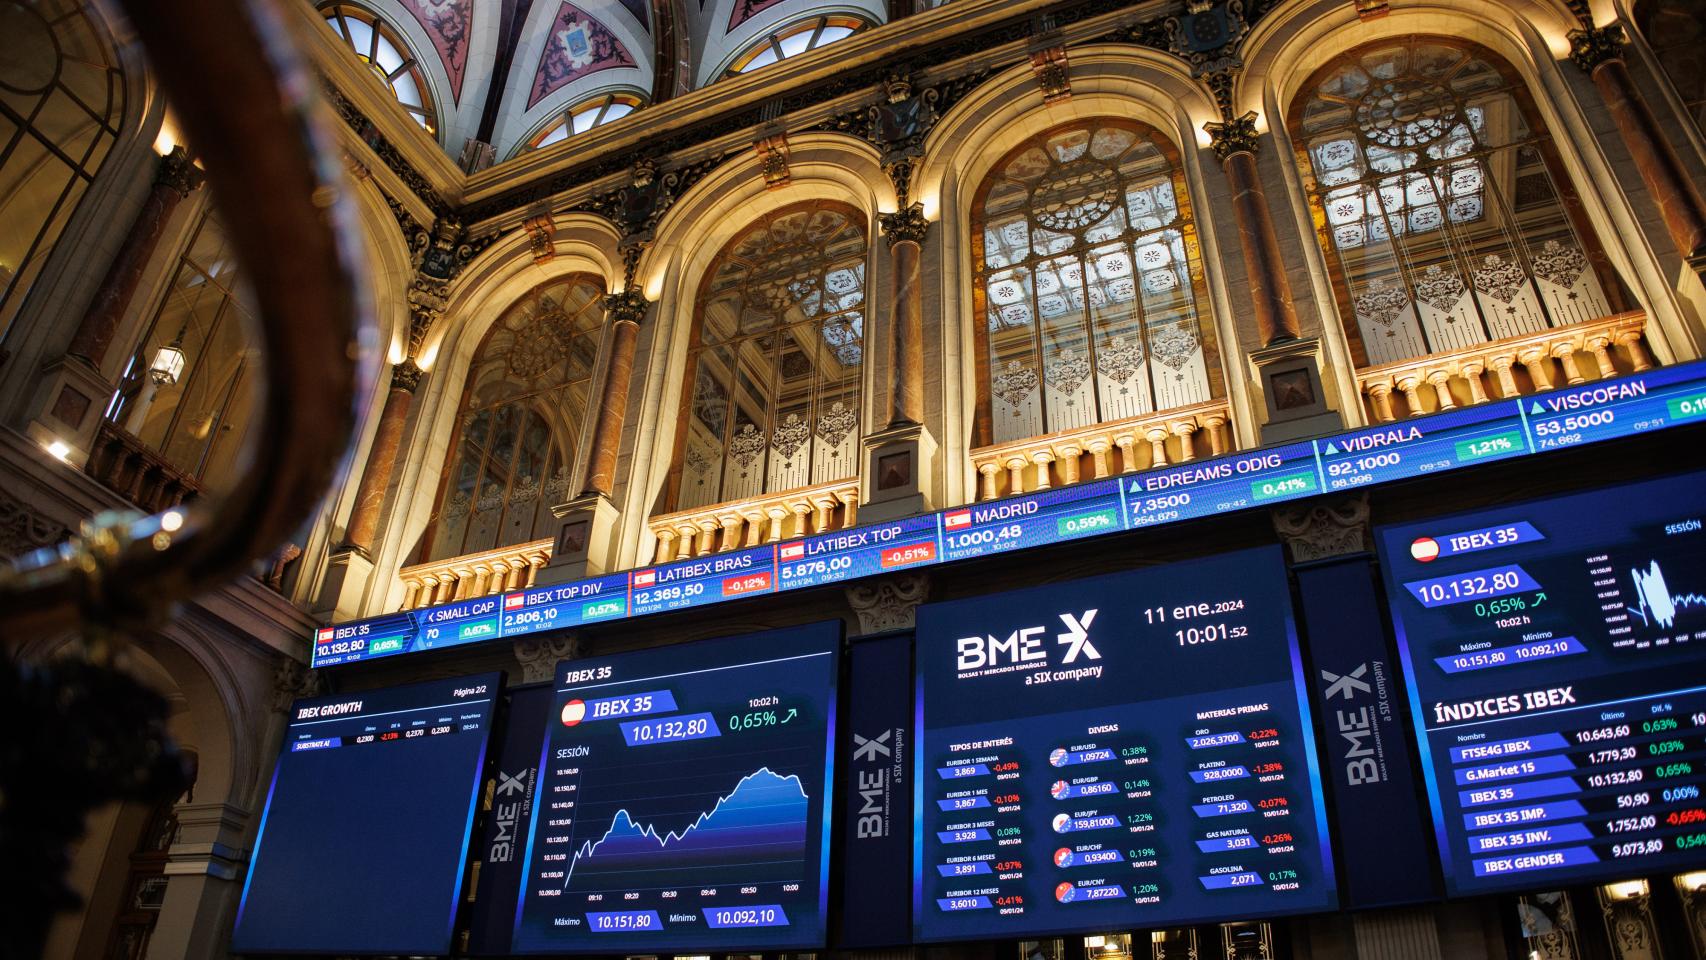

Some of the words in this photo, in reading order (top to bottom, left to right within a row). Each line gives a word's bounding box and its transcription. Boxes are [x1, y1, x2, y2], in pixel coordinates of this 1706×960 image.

[1548, 380, 1646, 412] VISCOFAN
[1536, 411, 1614, 436] 53,5000
[1634, 418, 1664, 430] 09:51
[1342, 427, 1423, 452] VIDRALA
[1468, 438, 1511, 455] 1,21%
[1328, 452, 1400, 476] 92,1000
[1146, 464, 1232, 491] EDREAMS
[1236, 454, 1282, 474] ODIG
[1262, 478, 1306, 494] 0,41%
[1130, 494, 1190, 514] 7,3500
[975, 501, 1038, 524] MADRID
[1066, 515, 1109, 530] 0,59%
[1665, 520, 1702, 534] SESIÓN
[808, 533, 868, 555] LATIBEX
[871, 526, 902, 542] TOP
[947, 525, 1022, 549] 1.000,48
[1450, 532, 1494, 552] IBEX
[1496, 528, 1518, 544] 35
[887, 547, 928, 562] -0,51%
[658, 562, 712, 582] LATIBEX
[716, 556, 752, 572] BRAS
[782, 556, 852, 580] 5.876,00
[728, 578, 766, 591] -0,12%
[1420, 572, 1519, 602] 10.132,80
[527, 592, 552, 605] IBEX
[556, 586, 579, 601] TOP
[582, 582, 602, 595] DIV
[634, 583, 704, 604] 12.369,50
[436, 609, 470, 621] SMALL
[472, 601, 494, 614] CAP
[588, 604, 618, 616] 0,57%
[1475, 597, 1526, 617] 0,65%
[504, 608, 558, 626] 2.806,10
[1144, 607, 1166, 624] 11
[1496, 616, 1521, 628] 10:02
[1523, 616, 1530, 624] h
[336, 626, 357, 640] IBEX
[359, 624, 370, 636] 35
[1522, 630, 1552, 642] Mínimo
[318, 640, 364, 656] 10.132,80
[958, 626, 1047, 670] BME
[1460, 641, 1492, 652] Máximo
[1516, 642, 1568, 658] 10.092,10
[1454, 652, 1505, 668] 10.151,80
[566, 668, 595, 684] IBEX
[596, 666, 612, 679] 35
[984, 666, 1015, 676] MERCADOS
[1016, 662, 1047, 670] ESPAÑOLES
[1026, 676, 1032, 685] a
[1034, 672, 1052, 684] SIX
[1053, 666, 1102, 682] company
[1372, 661, 1387, 700] company
[454, 687, 475, 698] Página
[476, 686, 486, 694] 2/2
[593, 698, 630, 717] IBEX
[633, 696, 652, 712] 35
[748, 697, 772, 708] 10:02
[773, 696, 778, 705] h
[1379, 702, 1390, 715] SIX
[1434, 695, 1520, 722] ÍNDICES
[1524, 686, 1576, 710] IBEX
[298, 707, 320, 719] IBEX
[320, 701, 362, 716] GROWTH
[1197, 708, 1236, 720] MATERIAS
[1238, 704, 1268, 714] PRIMAS
[729, 710, 777, 730] 0,65%
[1642, 718, 1678, 733] 0,63%
[633, 719, 707, 742] 10.132,80
[1088, 724, 1118, 734] DIVISAS
[1576, 725, 1630, 742] 10.643,60
[1193, 734, 1238, 747] 2.026,3700
[1458, 732, 1486, 742] Nombre
[556, 746, 590, 758] SESIÓN
[896, 728, 904, 762] company
[950, 744, 971, 752] TIPOS
[983, 738, 1012, 748] INTERÉS
[1071, 744, 1096, 752] EUR/USD
[1336, 707, 1380, 786] BME
[1462, 744, 1502, 759] FTSE4G
[1504, 740, 1530, 753] IBEX
[1650, 740, 1684, 755] 0,03%
[1080, 752, 1110, 762] 1,09724
[1589, 748, 1636, 764] 1.779,30
[894, 764, 902, 778] SIX
[954, 768, 976, 777] 3,869
[1199, 761, 1226, 769] PLATINO
[1466, 765, 1519, 780] G.Market
[1521, 762, 1535, 773] 15
[1656, 762, 1691, 777] 0,65%
[1204, 768, 1242, 780] 928,0000
[1588, 769, 1642, 787] 10.132,80
[1081, 784, 1112, 795] 0,86160
[1125, 780, 1150, 790] 0,14%
[1202, 794, 1234, 803] PETROLEO
[1470, 790, 1498, 803] IBEX
[1500, 788, 1514, 799] 35
[1618, 792, 1650, 808] 50,90
[1663, 785, 1698, 801] 0,00%
[858, 768, 883, 838] BME
[954, 799, 976, 808] 3,867
[1218, 802, 1247, 813] 71,320
[1074, 818, 1114, 829] 159,81000
[1128, 814, 1152, 824] 1,22%
[1475, 813, 1503, 826] IBEX
[1504, 811, 1518, 822] 35
[1520, 808, 1546, 820] IMP.
[1606, 816, 1656, 832] 1.752,00
[490, 802, 516, 862] BME
[955, 832, 976, 841] 3,928
[1220, 828, 1249, 836] NATURAL
[1480, 836, 1508, 848] IBEX
[1510, 834, 1524, 845] 35
[1526, 831, 1551, 843] INV.
[1227, 838, 1250, 848] 3,031
[1612, 840, 1662, 857] 9.073,80
[1084, 852, 1116, 863] 0,93400
[1130, 848, 1155, 858] 0,19%
[955, 865, 976, 874] 3,891
[1210, 866, 1243, 874] GASOLINA
[1484, 860, 1513, 872] IBEX
[1515, 853, 1564, 869] GENDER
[1232, 874, 1254, 884] 2,071
[1270, 870, 1296, 881] 0,17%
[1087, 888, 1118, 898] 7,87220
[1133, 885, 1158, 894] 1,20%
[950, 899, 977, 908] 3,6010
[554, 918, 580, 926] Máximo
[598, 915, 650, 929] 10.151,80
[670, 914, 696, 922] Mínimo
[716, 910, 774, 924] 10.092,10
